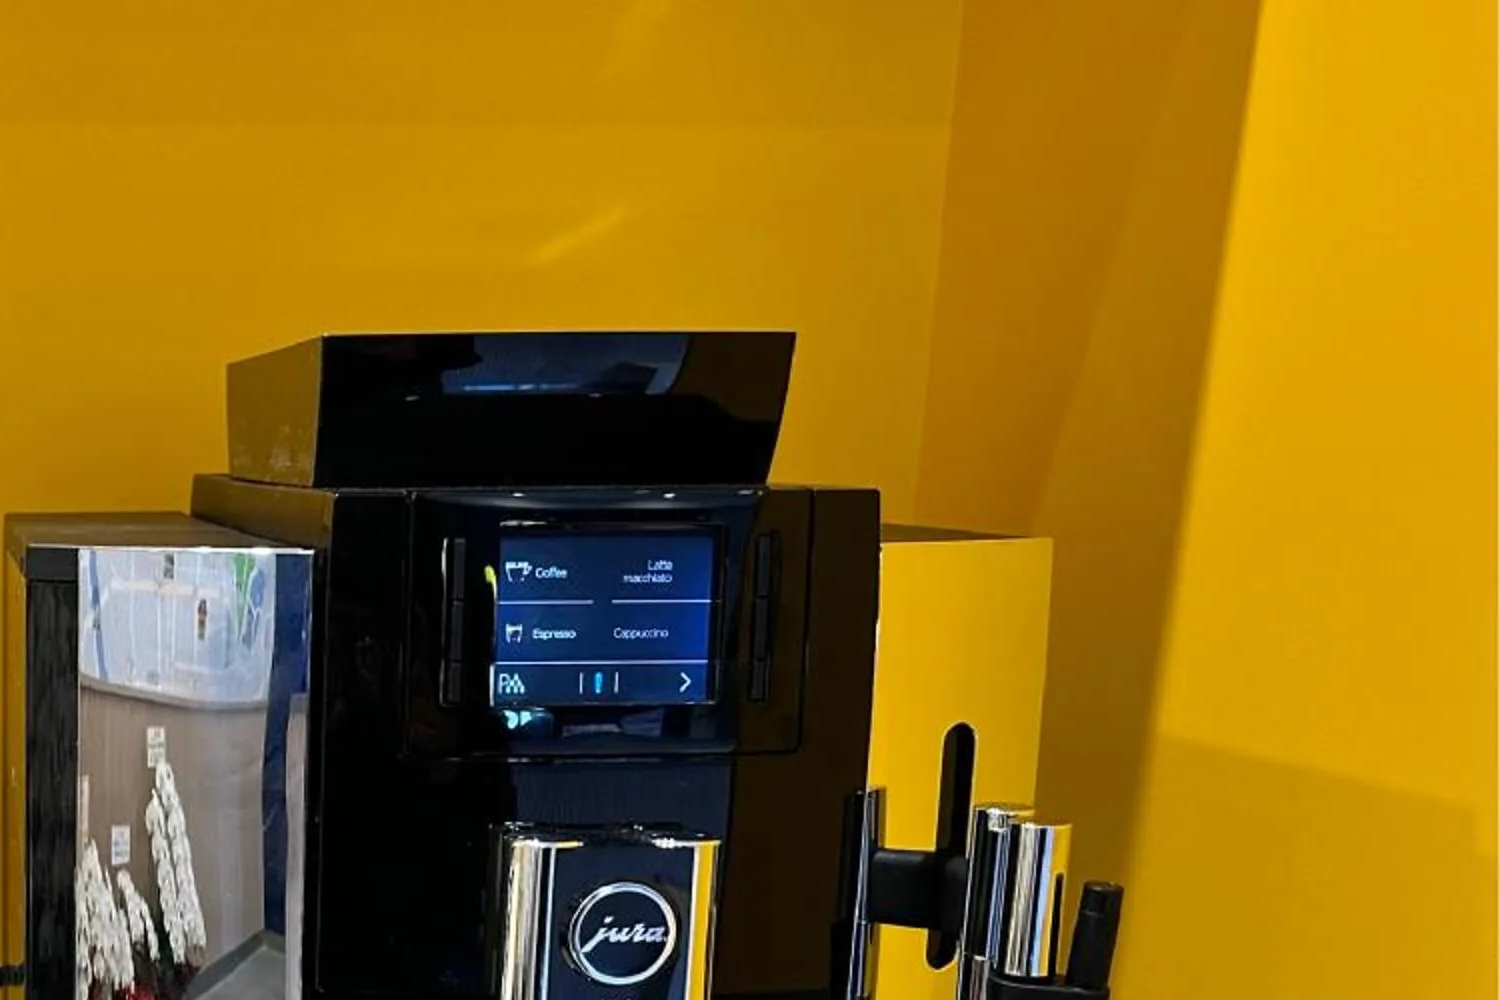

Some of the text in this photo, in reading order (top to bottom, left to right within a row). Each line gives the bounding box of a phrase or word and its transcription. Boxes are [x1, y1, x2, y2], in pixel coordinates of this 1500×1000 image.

[535, 567, 568, 579] Coffee
[623, 572, 673, 583] macchiato
[532, 628, 577, 640] Espresso
[613, 627, 669, 639] Cappuccino
[579, 916, 666, 953] jura
